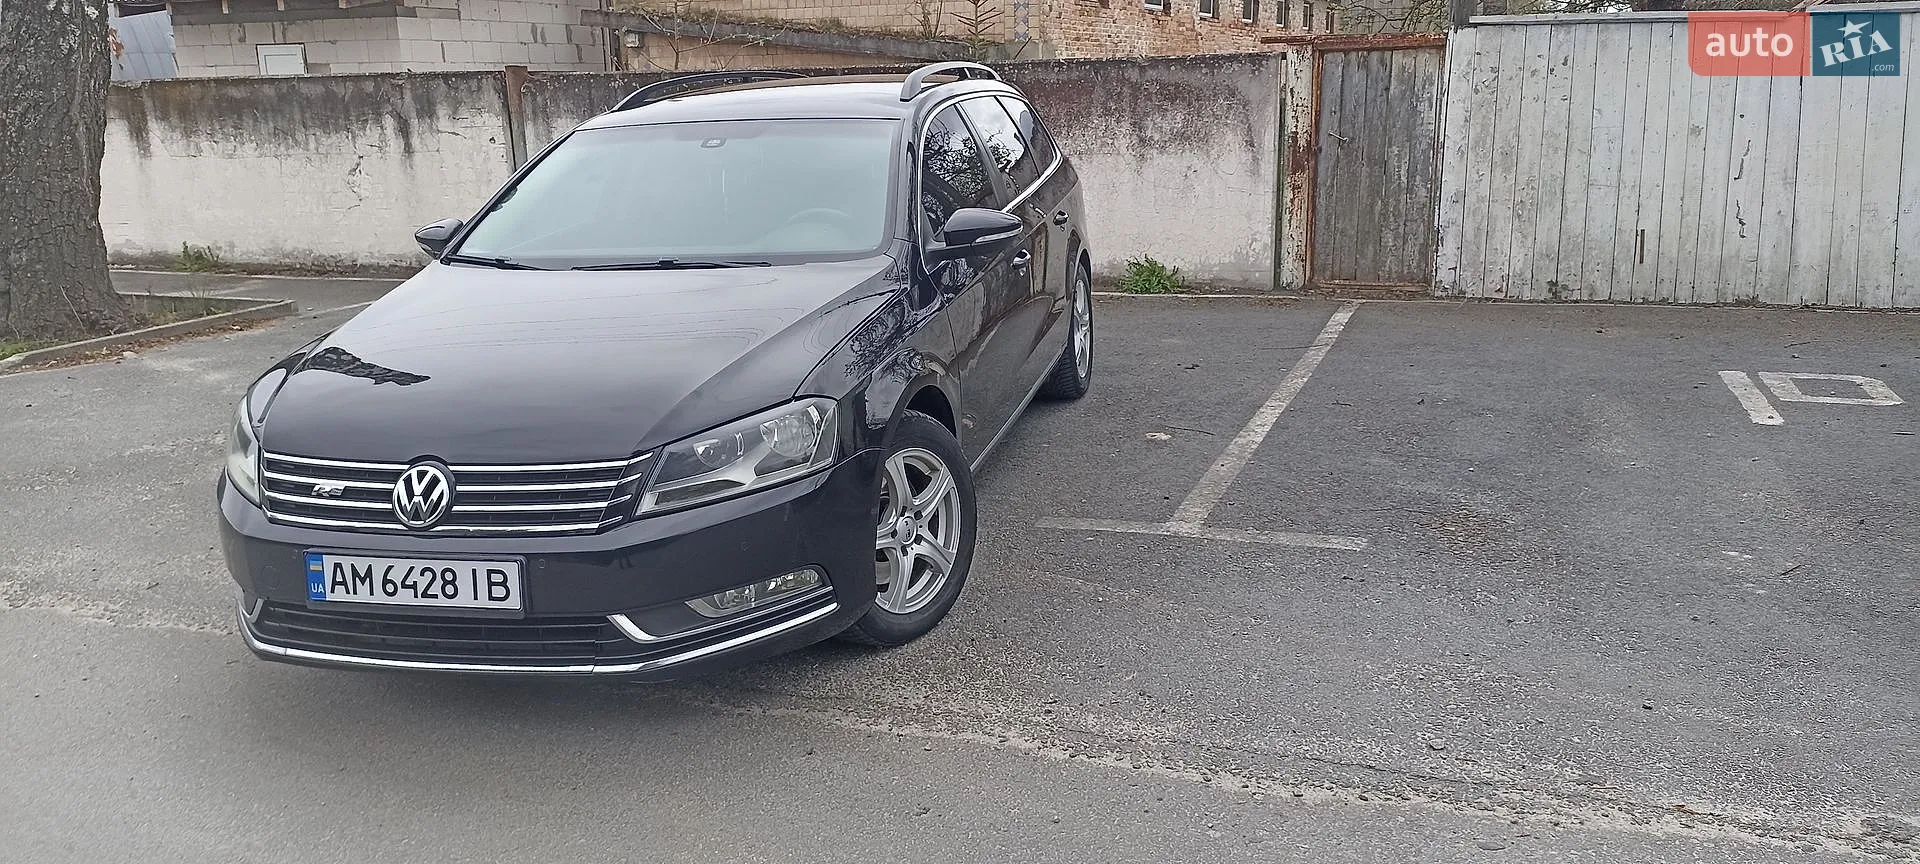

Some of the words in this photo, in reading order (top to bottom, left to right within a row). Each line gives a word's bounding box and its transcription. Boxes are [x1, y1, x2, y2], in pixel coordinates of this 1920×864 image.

[311, 583, 325, 593] UA
[330, 562, 375, 597] AM
[381, 564, 459, 600] 6428
[471, 568, 511, 602] IB
